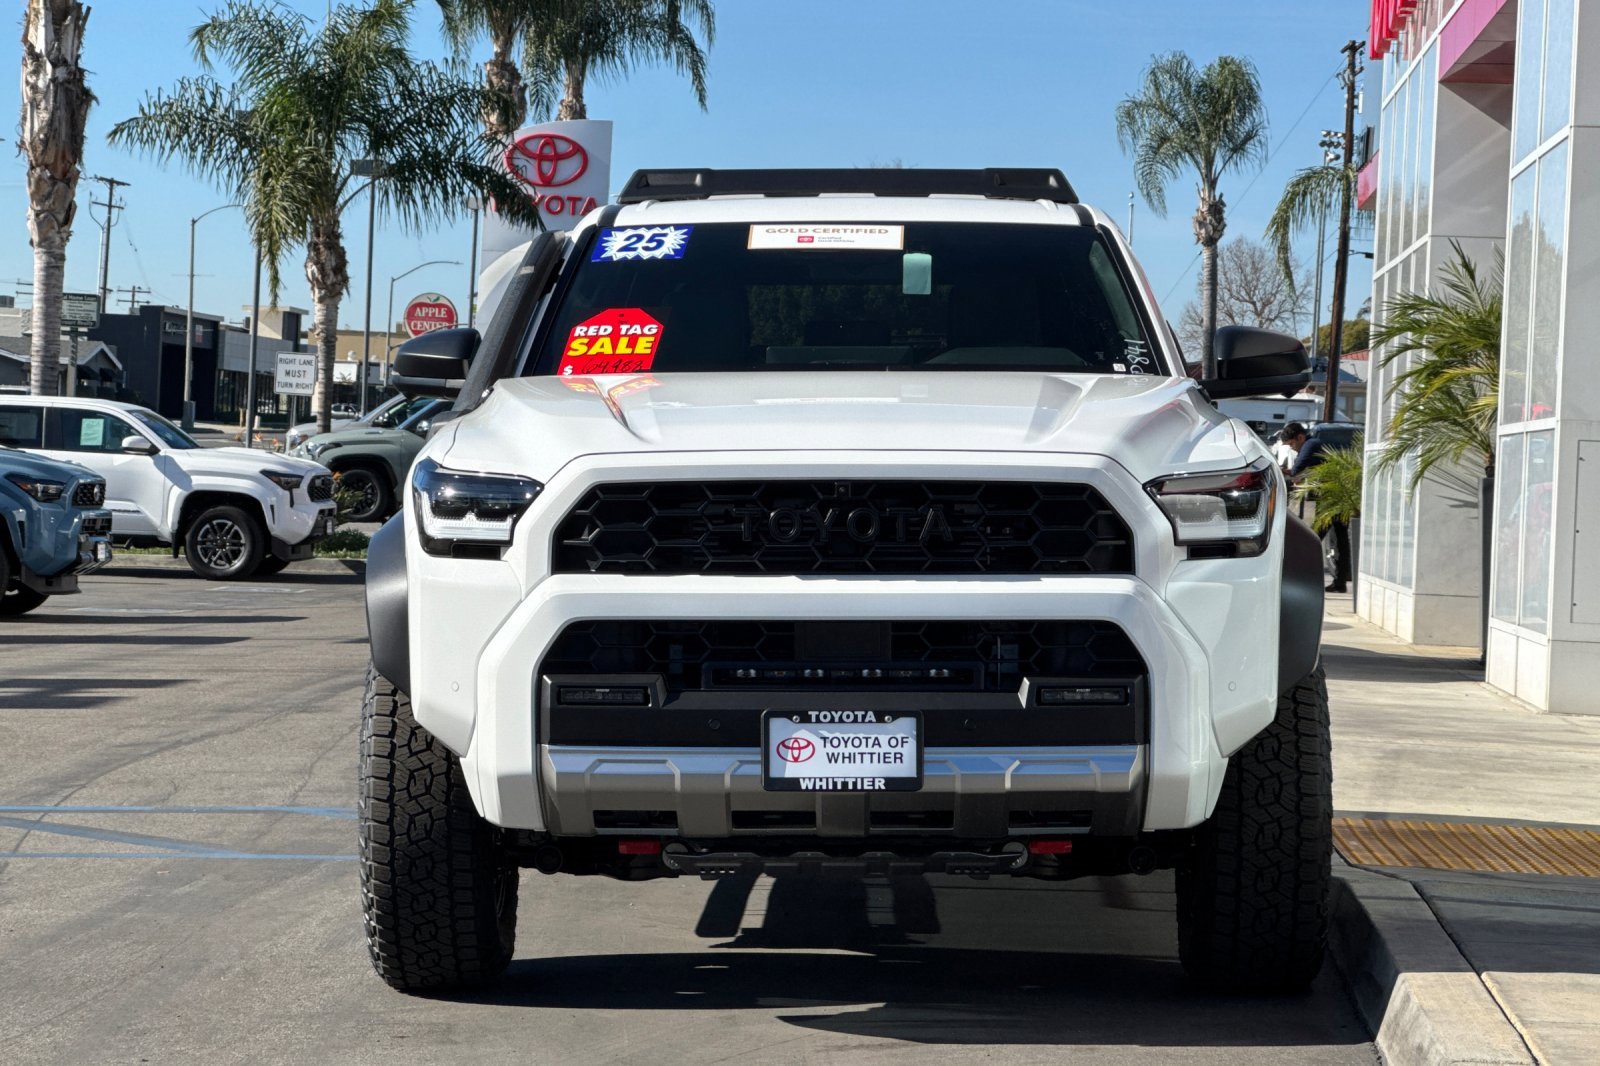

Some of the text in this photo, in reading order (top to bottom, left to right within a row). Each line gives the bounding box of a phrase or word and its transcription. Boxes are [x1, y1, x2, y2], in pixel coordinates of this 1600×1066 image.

[765, 227, 889, 235] GOLD CERTIFIED
[615, 232, 669, 253] 25
[414, 306, 448, 318] APPLE
[573, 324, 659, 337] RED TAG
[567, 336, 655, 357] SALE
[278, 357, 297, 365] RIGHT
[284, 369, 307, 379] MUST
[277, 381, 313, 390] TURN RIGHT
[732, 507, 954, 543] TOYOTA
[808, 711, 877, 723] TOYOTA
[820, 736, 910, 748] TOYOTA OF
[826, 752, 904, 764] WHITTIER
[800, 778, 886, 790] WHITTIER
